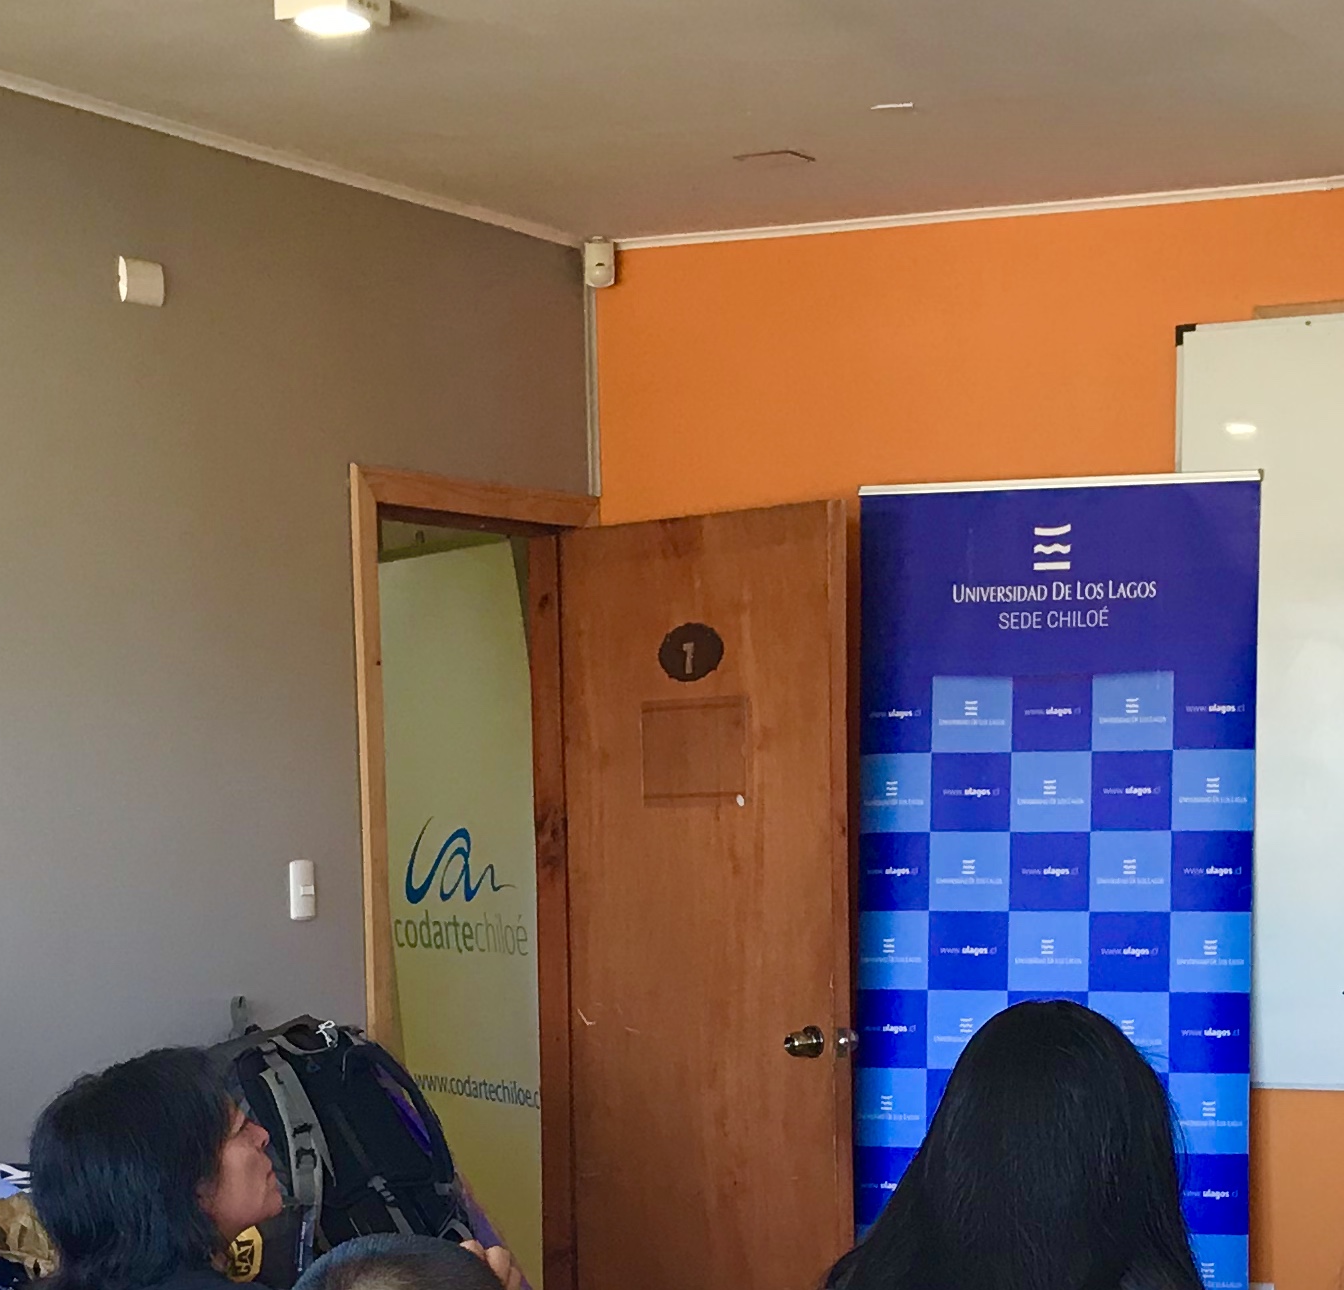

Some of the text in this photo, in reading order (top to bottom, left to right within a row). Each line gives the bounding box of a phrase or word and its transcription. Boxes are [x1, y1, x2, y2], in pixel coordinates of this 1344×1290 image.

[952, 579, 1157, 604] UNIVERSIDAD DE LOS LAGOS
[998, 605, 1110, 630] SEDE CHILOÉ
[394, 908, 529, 957] codartechiloé
